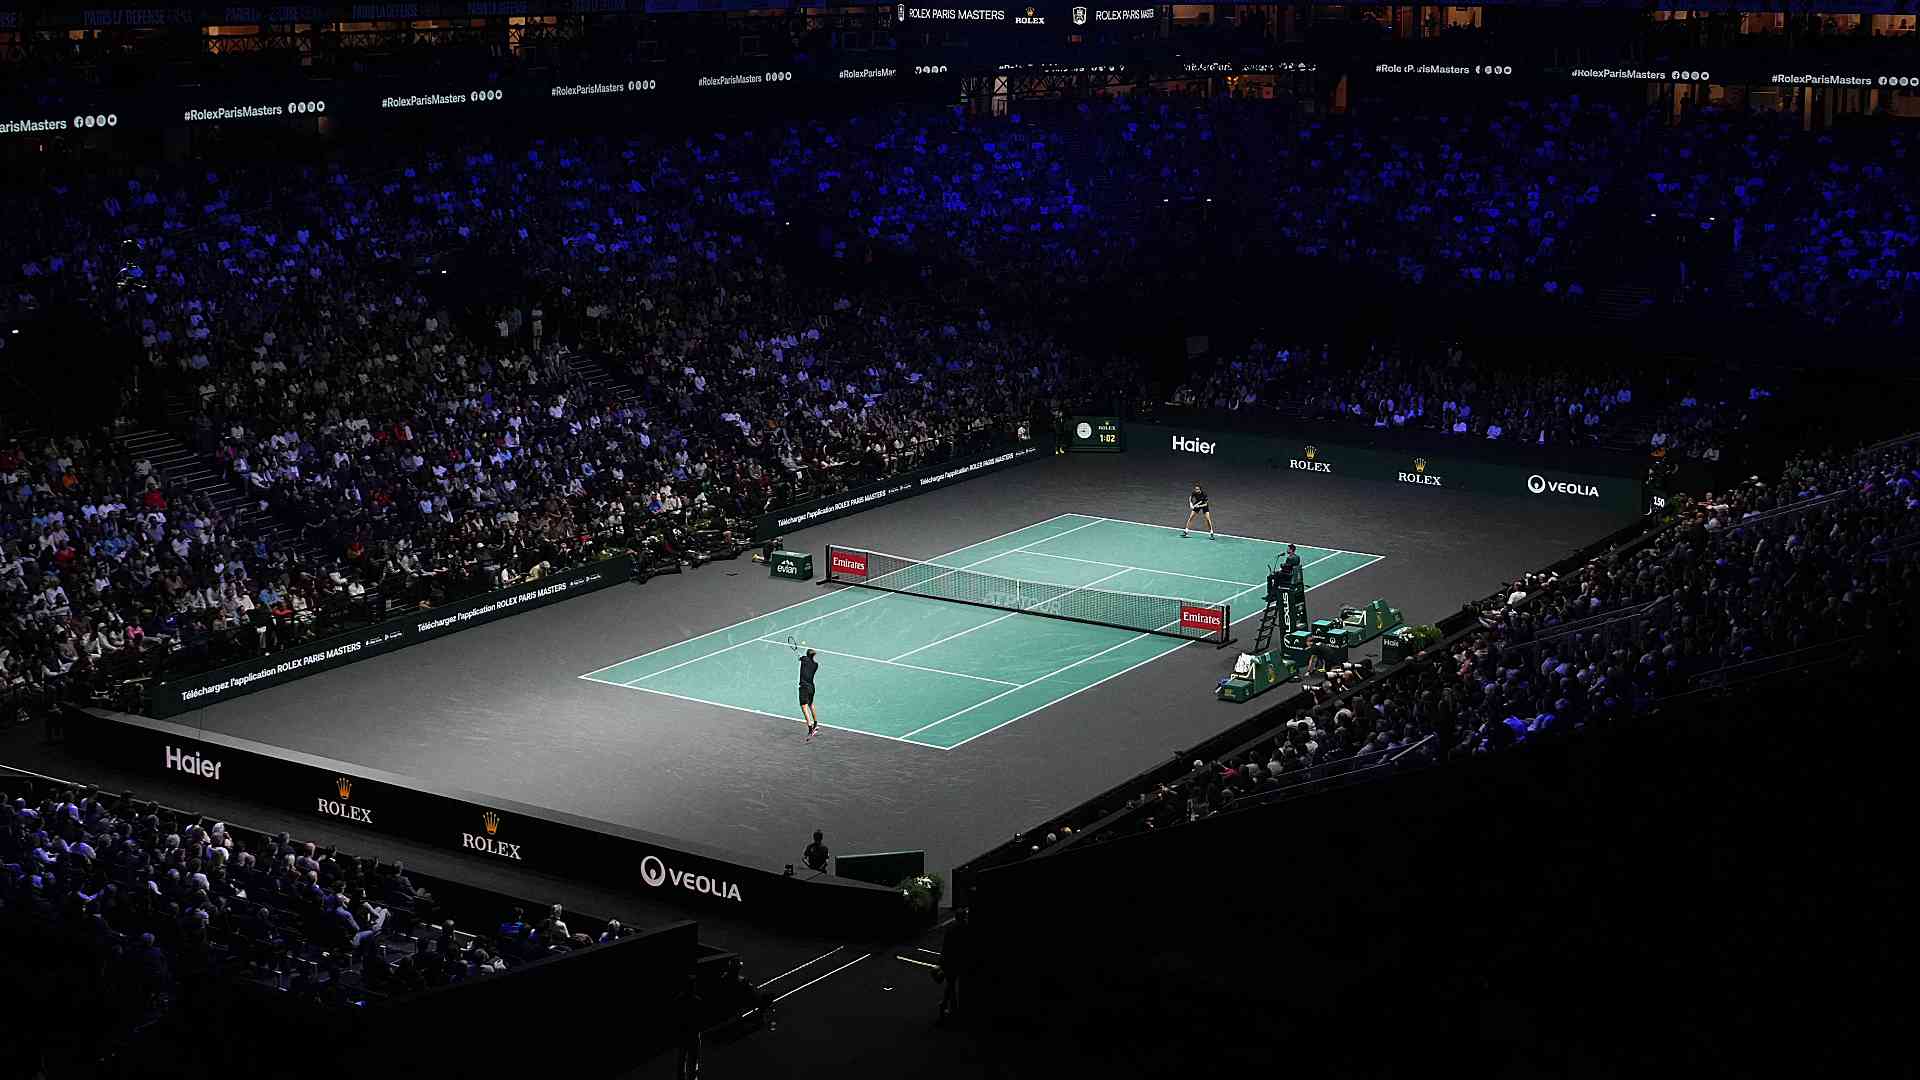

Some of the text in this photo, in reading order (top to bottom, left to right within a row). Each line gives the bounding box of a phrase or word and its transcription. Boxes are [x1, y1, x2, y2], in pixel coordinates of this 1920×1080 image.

[909, 8, 1005, 20] ROLEX PARIS MASTERS
[1095, 10, 1122, 20] ROLEX
[1122, 10, 1140, 20] PARIS
[698, 75, 762, 87] #RolexParisMasters
[1572, 69, 1666, 79] #RolexParisMasters
[1771, 74, 1872, 85] #RolexParisMasters
[551, 83, 624, 96] #RolexParisMasters
[382, 93, 466, 108] #RolexParisMasters
[184, 106, 282, 121] #RolexParisMasters
[0, 119, 67, 133] arisMasters
[1099, 434, 1116, 442] 1:02
[1172, 435, 1216, 455] Haier
[969, 461, 983, 471] ROLEX
[1289, 459, 1332, 473] ROLEX
[1398, 471, 1441, 486] ROLEX
[1547, 480, 1600, 497] VEOLIA
[834, 500, 851, 510] ROLEX
[850, 496, 865, 506] PARIS
[864, 489, 887, 502] MASTERS
[777, 564, 797, 574] evian
[833, 556, 865, 570] Emirates
[417, 582, 567, 633] Téléchargez l'application ROLEX PARIS MASTERS
[1282, 592, 1291, 633] LEXUS
[1183, 611, 1221, 625] Emirates
[181, 641, 362, 701] Téléchargez l'application ROLEX PARIS MASTERS
[165, 745, 222, 780] Haier
[317, 797, 373, 824] ROLEX
[462, 832, 522, 860] ROLEX
[669, 868, 742, 902] VEOLIA
